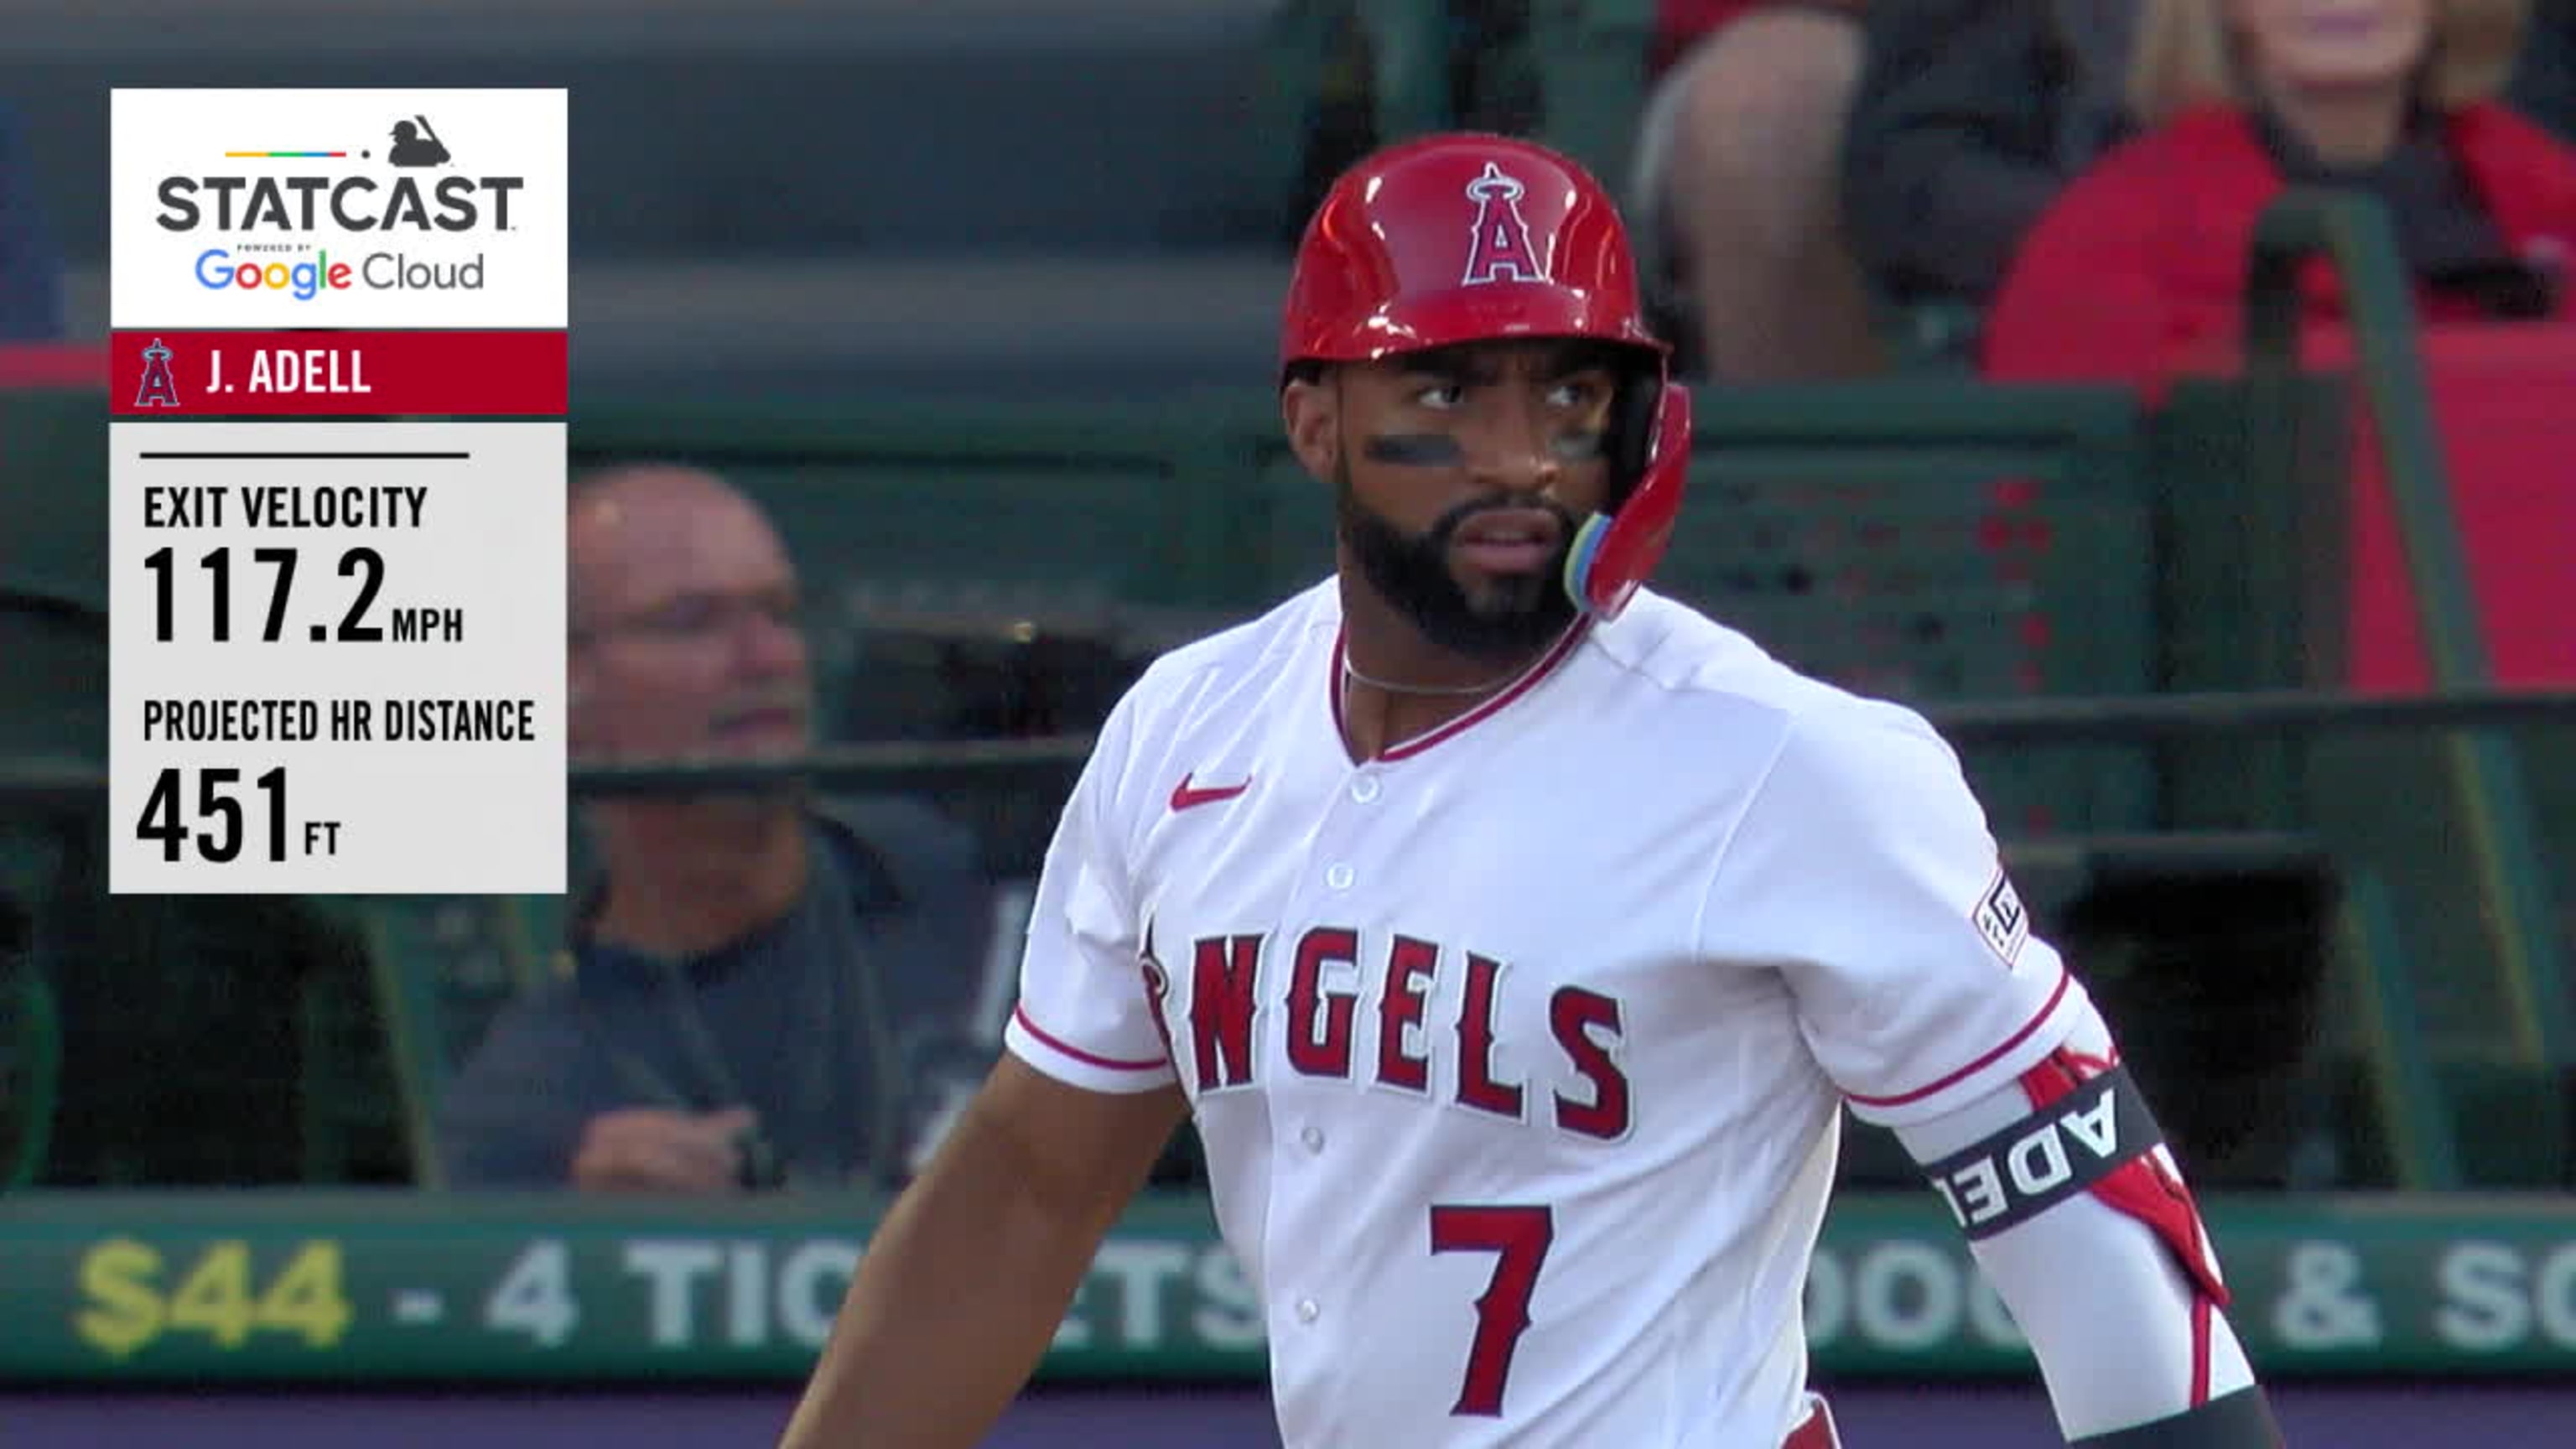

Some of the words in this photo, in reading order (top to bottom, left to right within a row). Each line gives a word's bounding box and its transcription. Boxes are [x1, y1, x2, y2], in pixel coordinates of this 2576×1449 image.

[77, 1236, 352, 1356] $44
[485, 1239, 579, 1348] 4
[2272, 1239, 2383, 1352] &
[1430, 1205, 1554, 1417] 7
